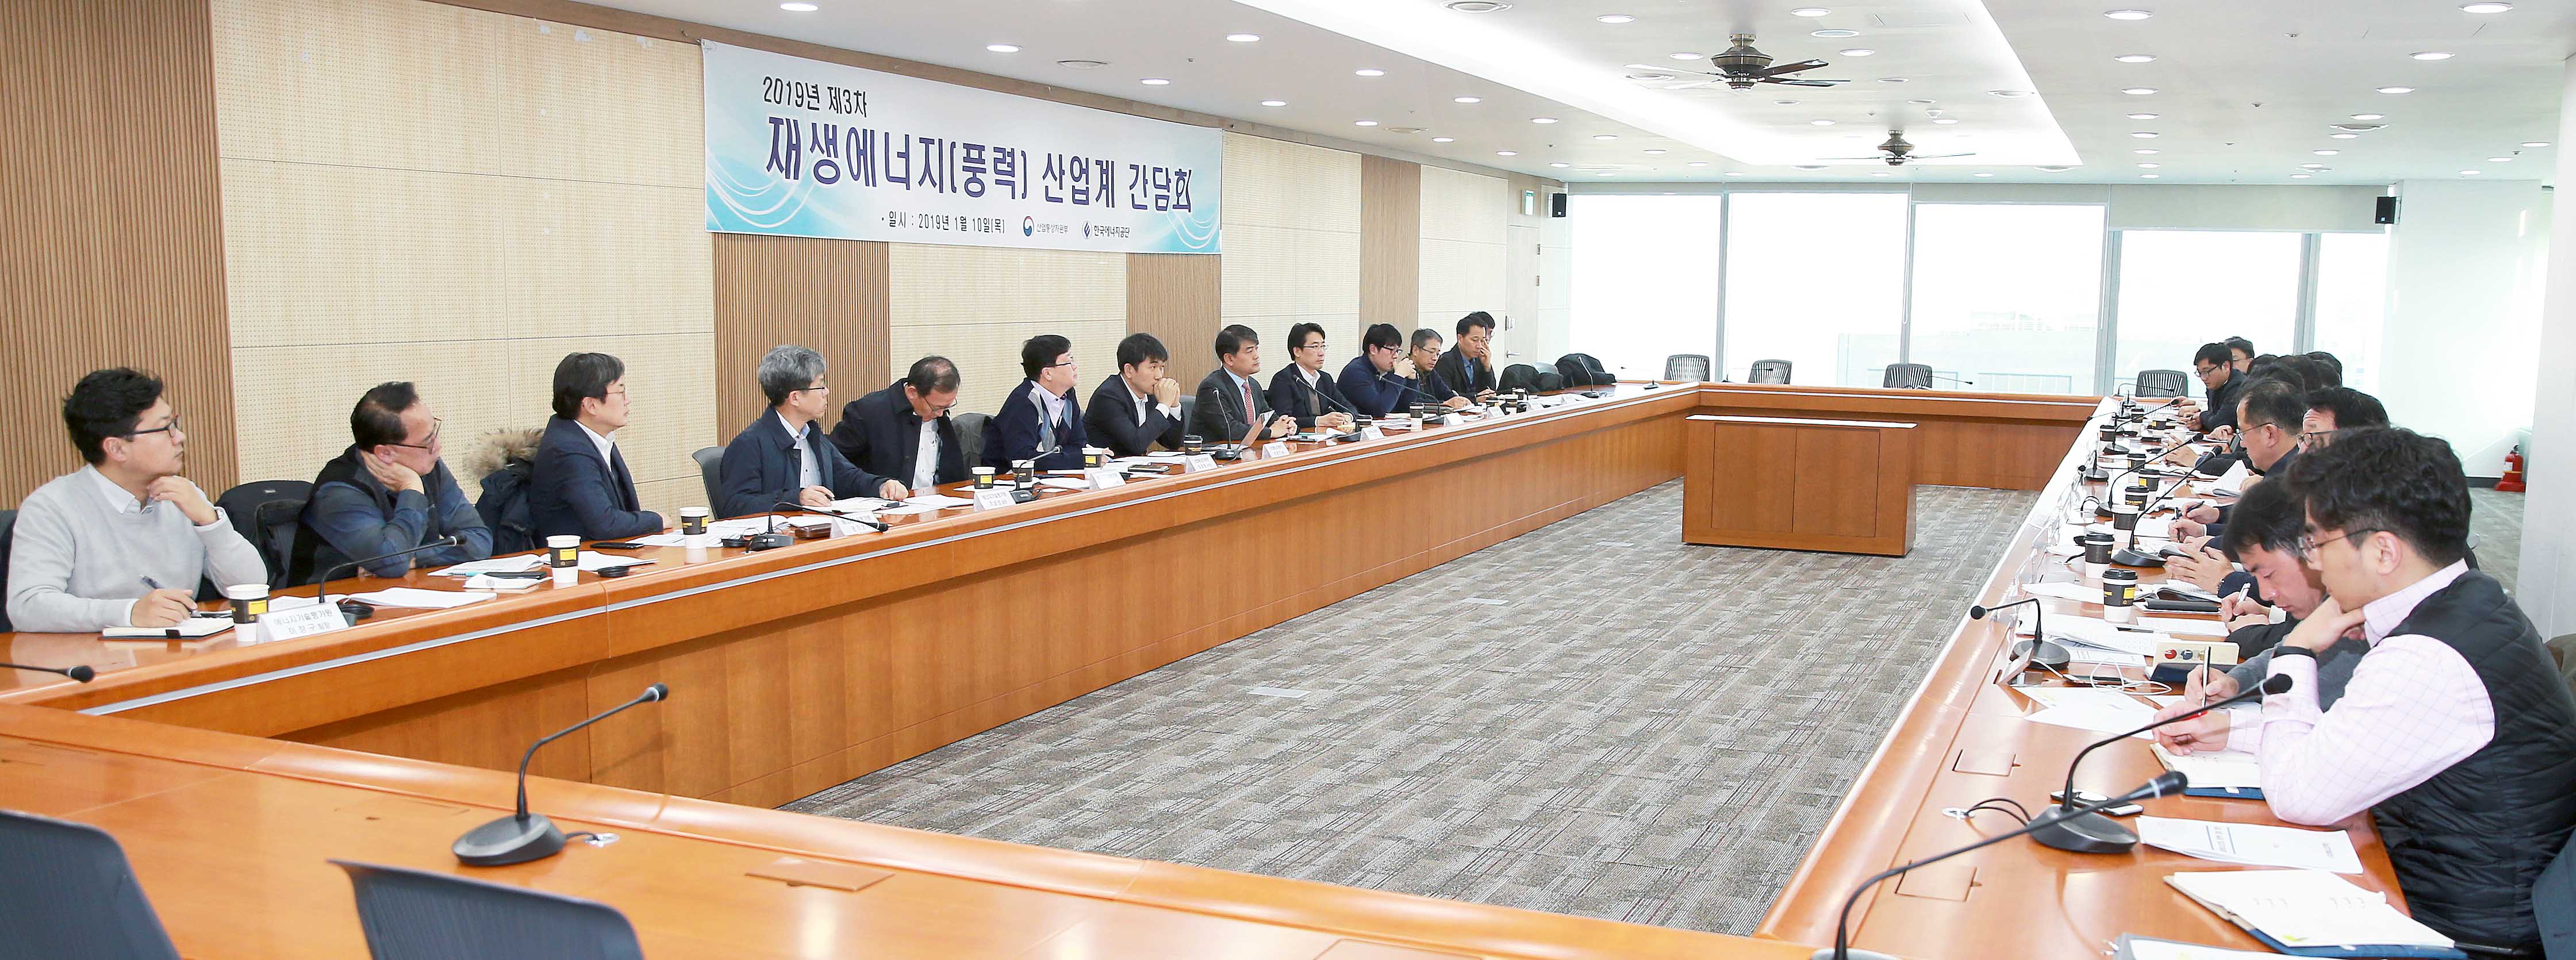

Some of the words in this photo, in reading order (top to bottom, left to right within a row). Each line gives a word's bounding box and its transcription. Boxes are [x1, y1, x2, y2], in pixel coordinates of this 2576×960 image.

[763, 76, 820, 111] 2019년
[827, 86, 867, 118] 제3차
[1042, 153, 1115, 208] 산업계
[1129, 164, 1192, 213] 간담회
[889, 211, 906, 228] 일시
[919, 213, 949, 231] 2019년
[954, 216, 967, 232] 1월
[1036, 223, 1068, 234] 산업통상자원부
[1094, 225, 1130, 238] 한국에너지공단
